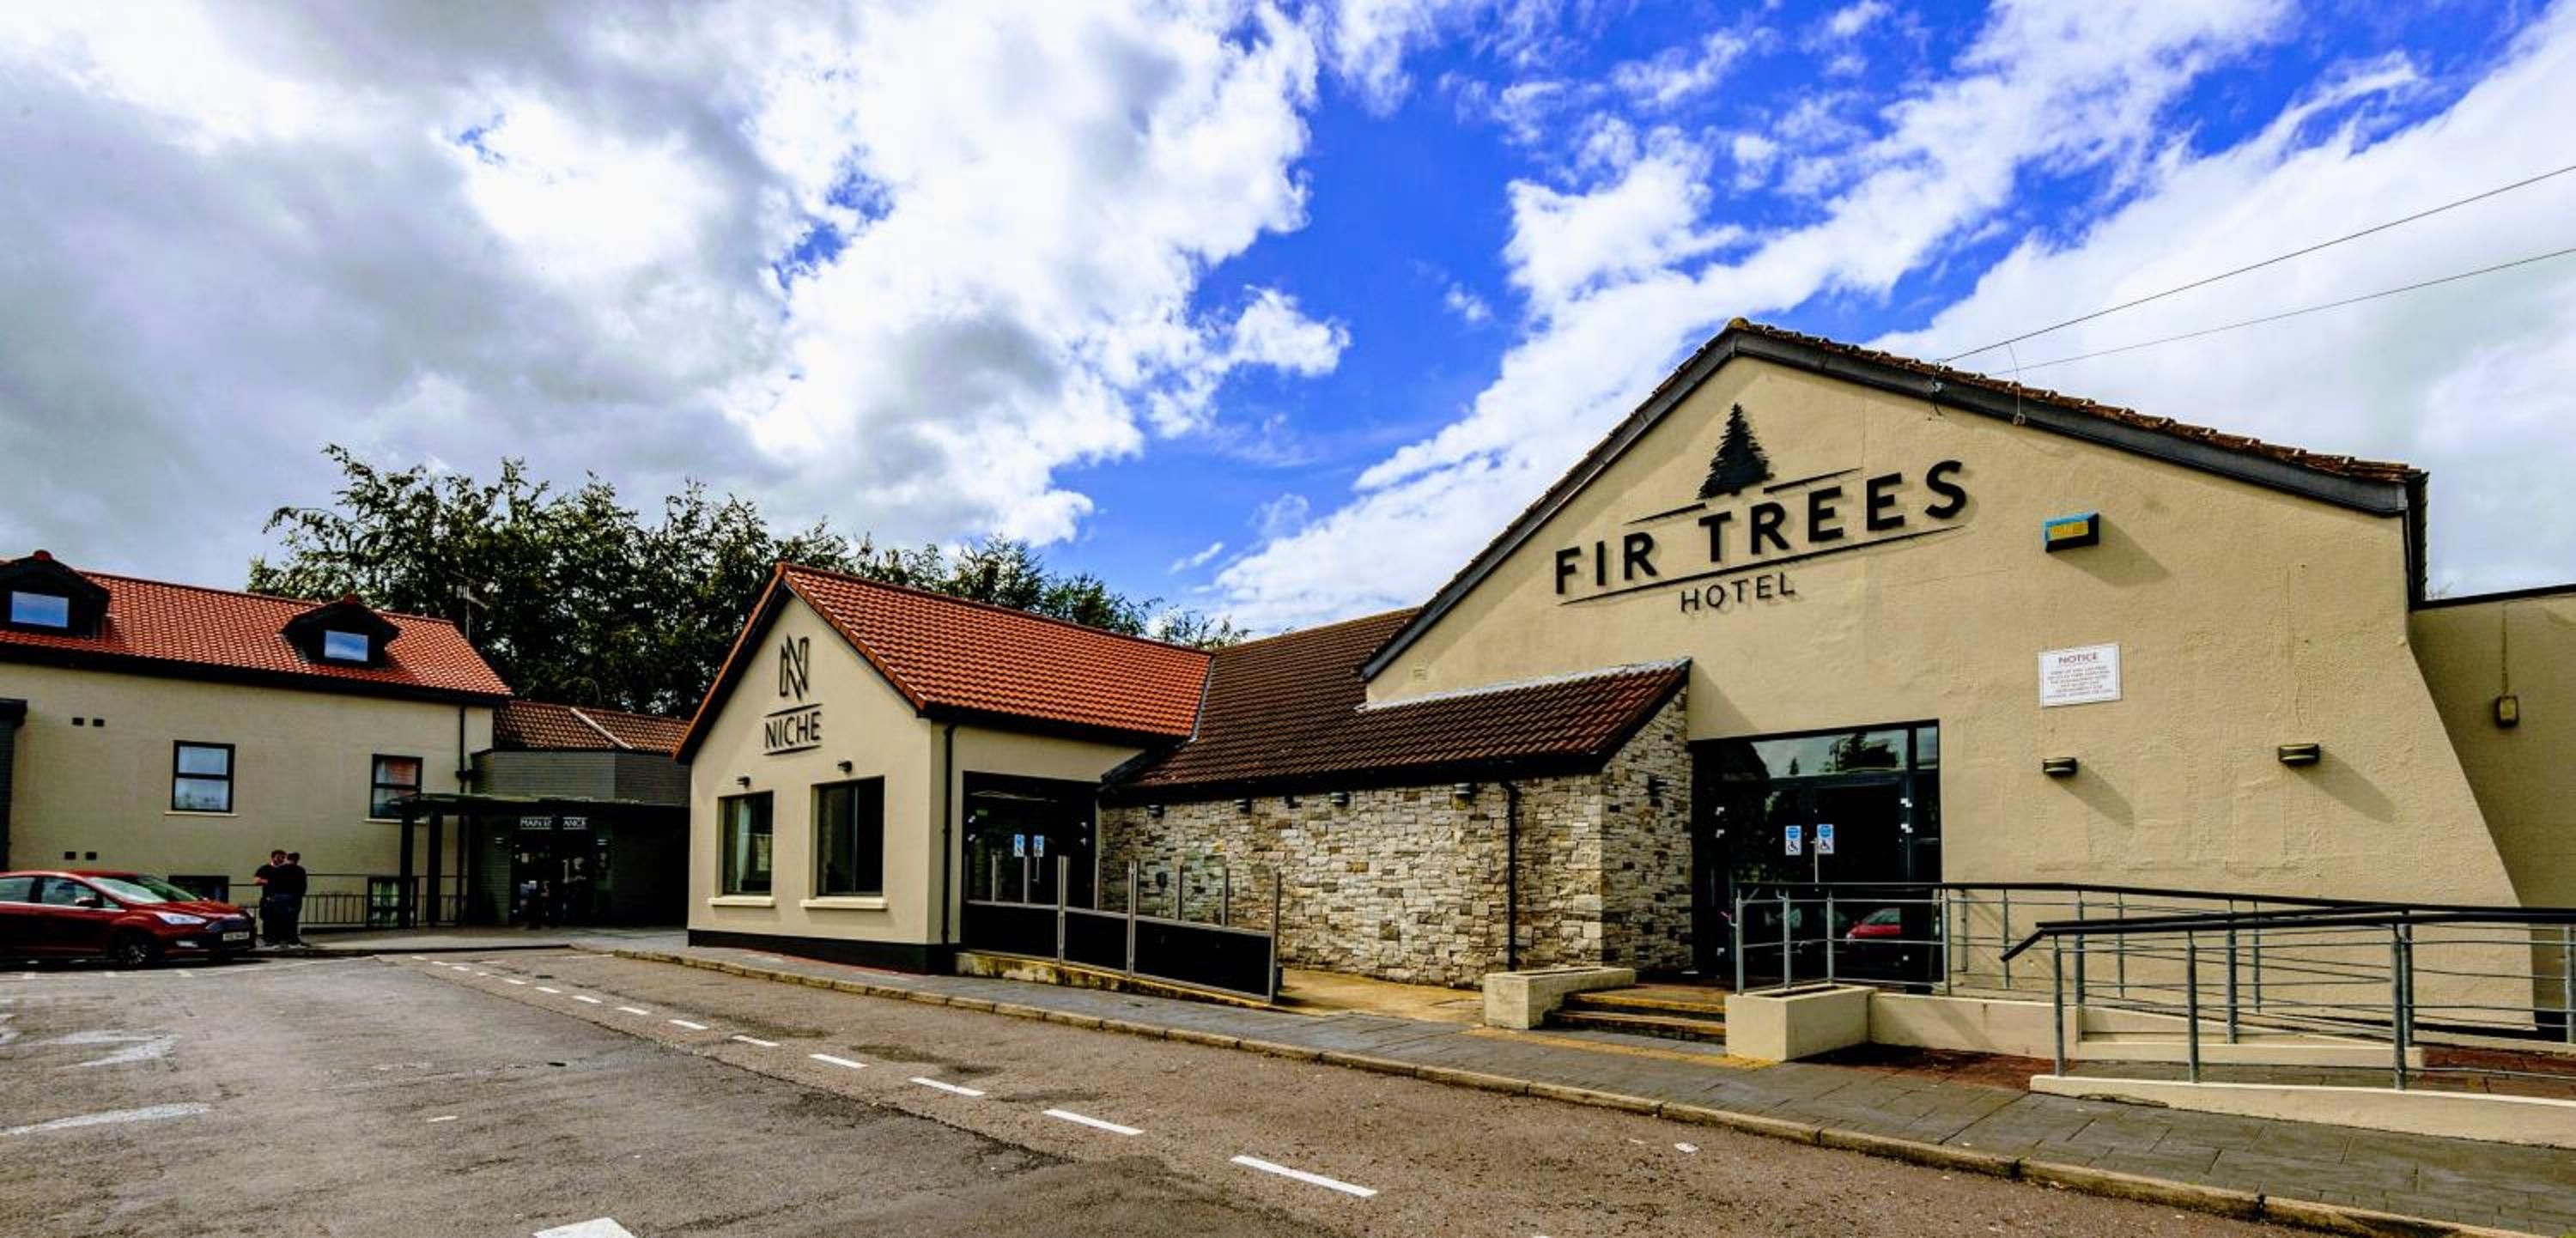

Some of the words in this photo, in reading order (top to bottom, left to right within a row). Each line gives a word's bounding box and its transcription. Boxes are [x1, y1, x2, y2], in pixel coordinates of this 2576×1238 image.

[1555, 531, 1658, 594] FIR
[1698, 460, 1967, 562] TREES
[1680, 572, 1795, 612] HOTEL
[2058, 652, 2097, 664] NOTICE
[765, 711, 821, 749] NICHE
